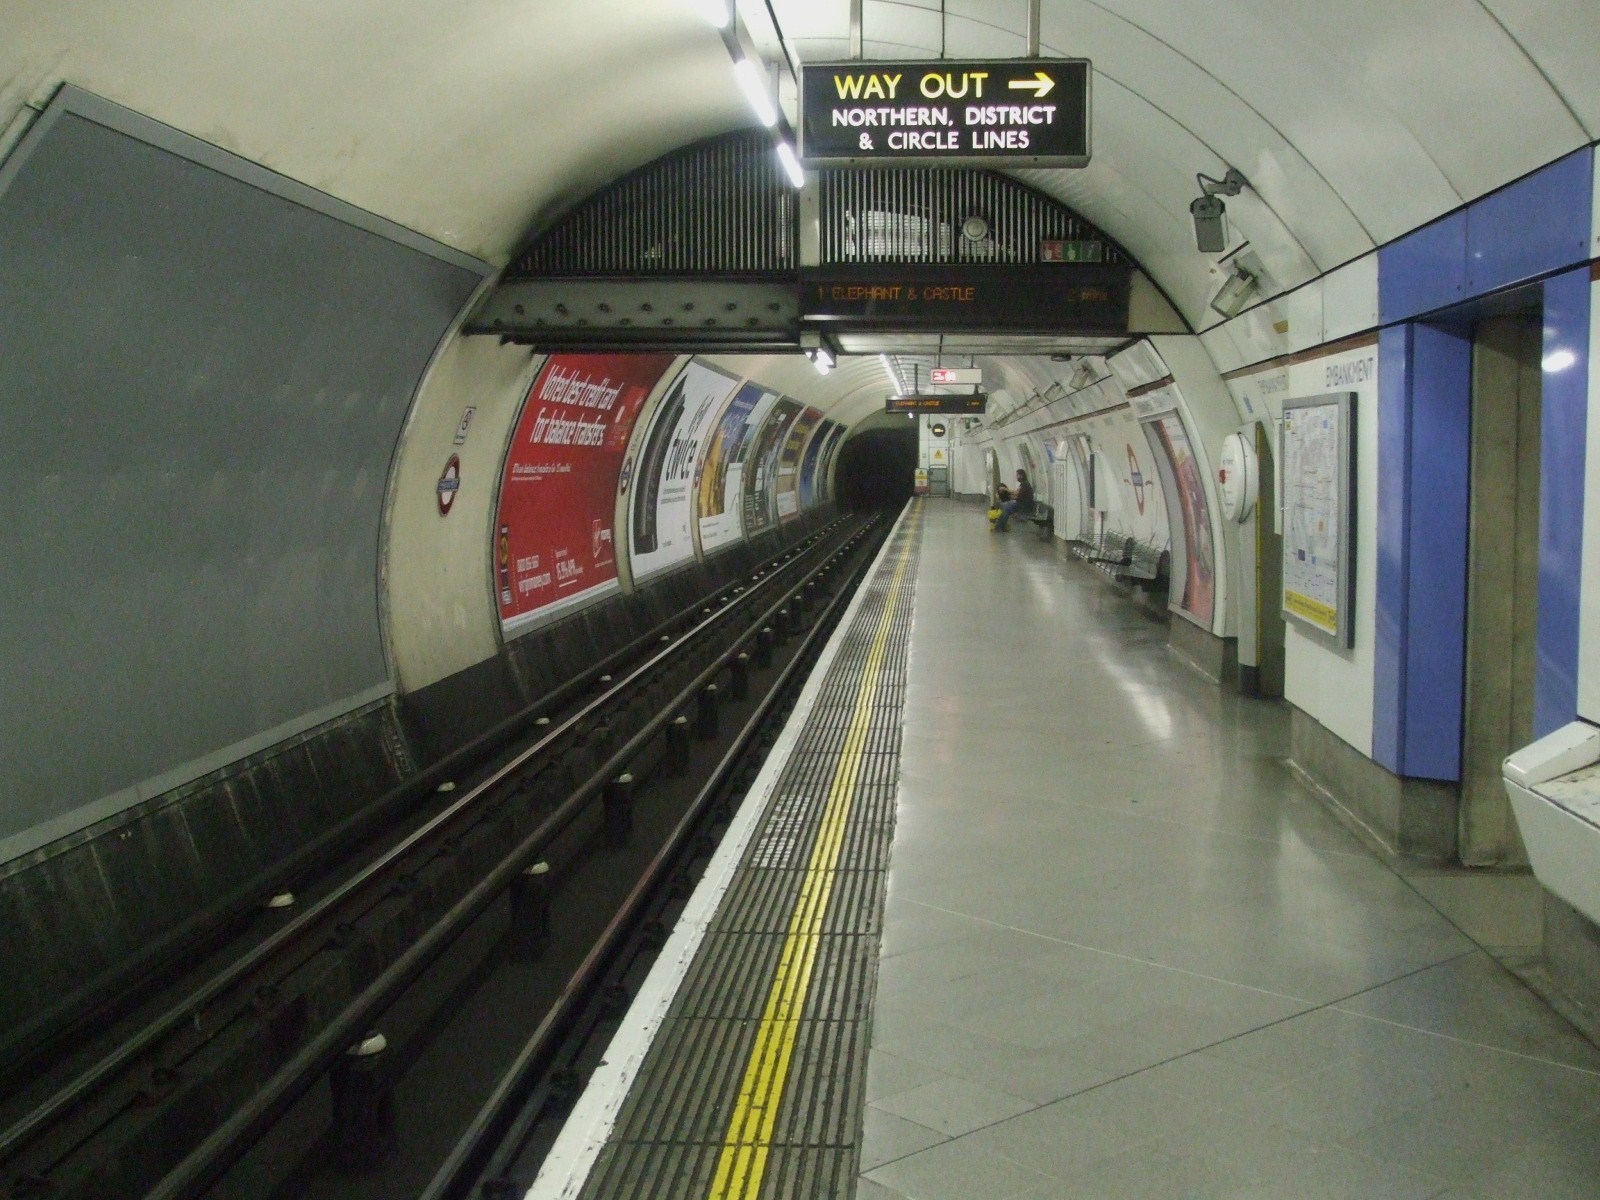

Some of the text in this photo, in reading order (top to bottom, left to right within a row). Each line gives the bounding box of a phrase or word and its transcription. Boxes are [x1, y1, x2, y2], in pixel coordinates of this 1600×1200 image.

[834, 72, 989, 100] WAY OUT
[832, 105, 1056, 128] NORTHERN, DISTRICT
[858, 130, 1030, 150] & CIRCLE LINES
[818, 287, 825, 300] 1
[832, 286, 900, 300] ELEPHANT
[908, 287, 917, 300] &
[923, 287, 975, 300] CASTLE
[538, 364, 625, 411] Voted best credit card
[529, 406, 607, 446] for balance transfers
